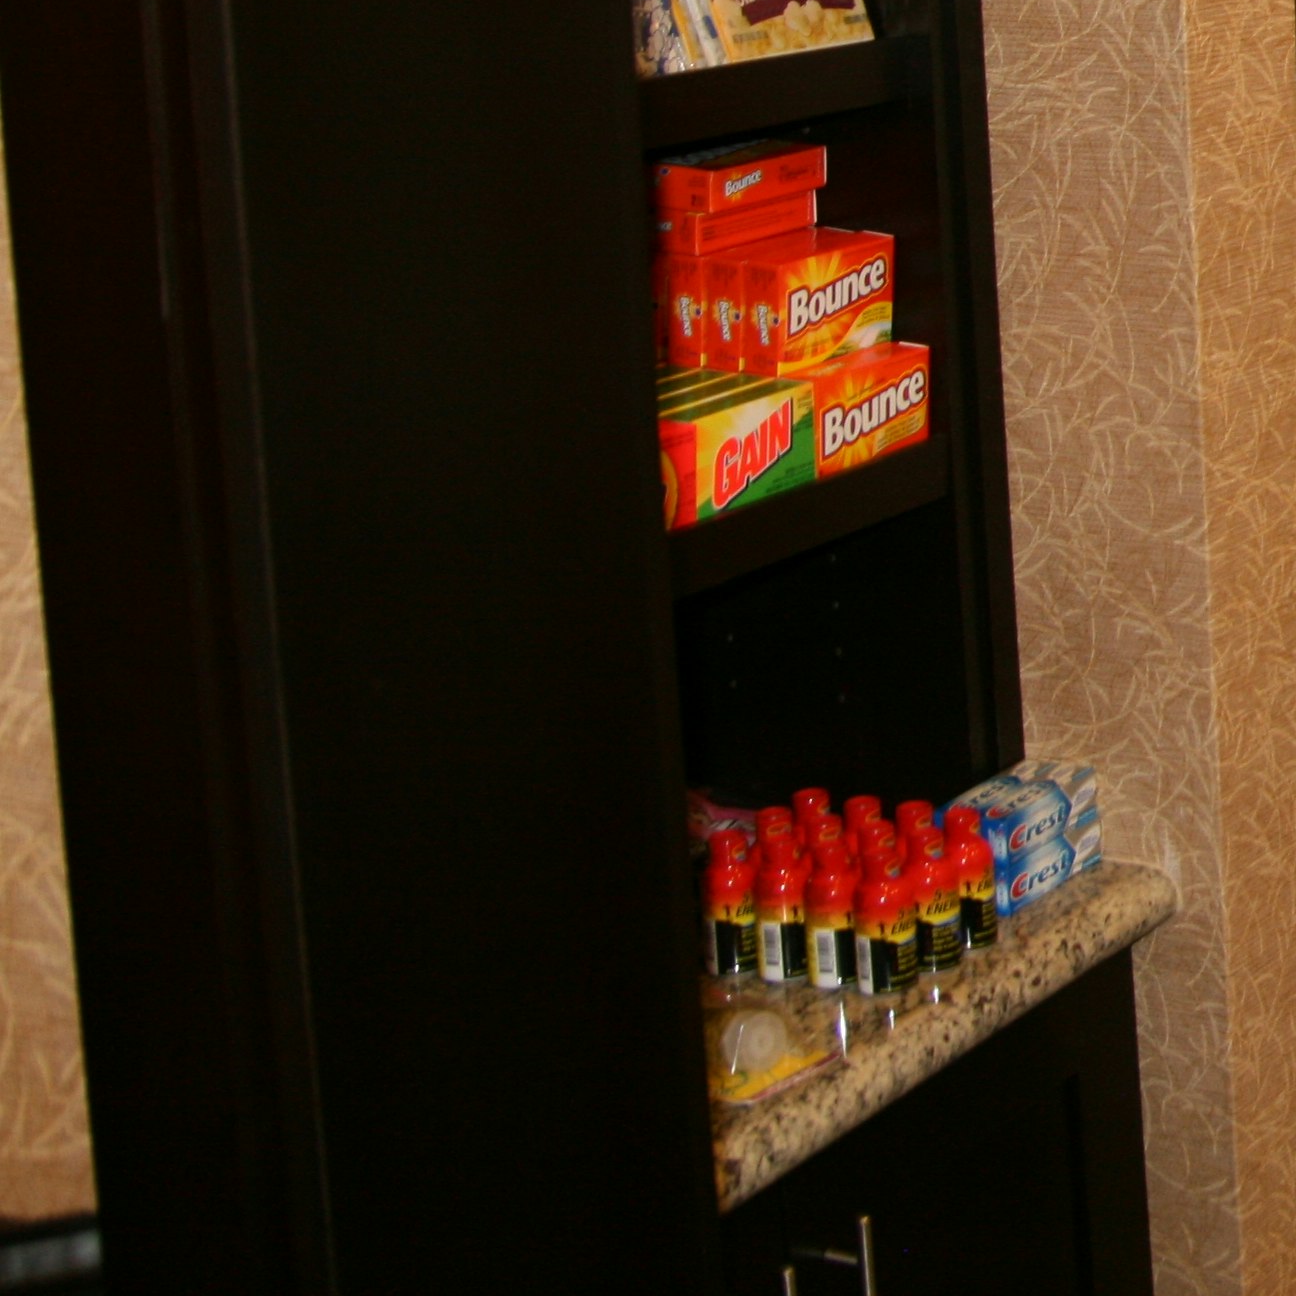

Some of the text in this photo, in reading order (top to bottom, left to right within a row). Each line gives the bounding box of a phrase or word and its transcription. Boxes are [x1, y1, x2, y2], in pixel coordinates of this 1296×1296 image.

[725, 169, 762, 197] Bounce
[788, 257, 885, 336] Bounce
[823, 370, 925, 457] Bounce
[712, 397, 794, 510] GAIN
[1009, 801, 1067, 852] Crest
[1011, 848, 1071, 901] Crest
